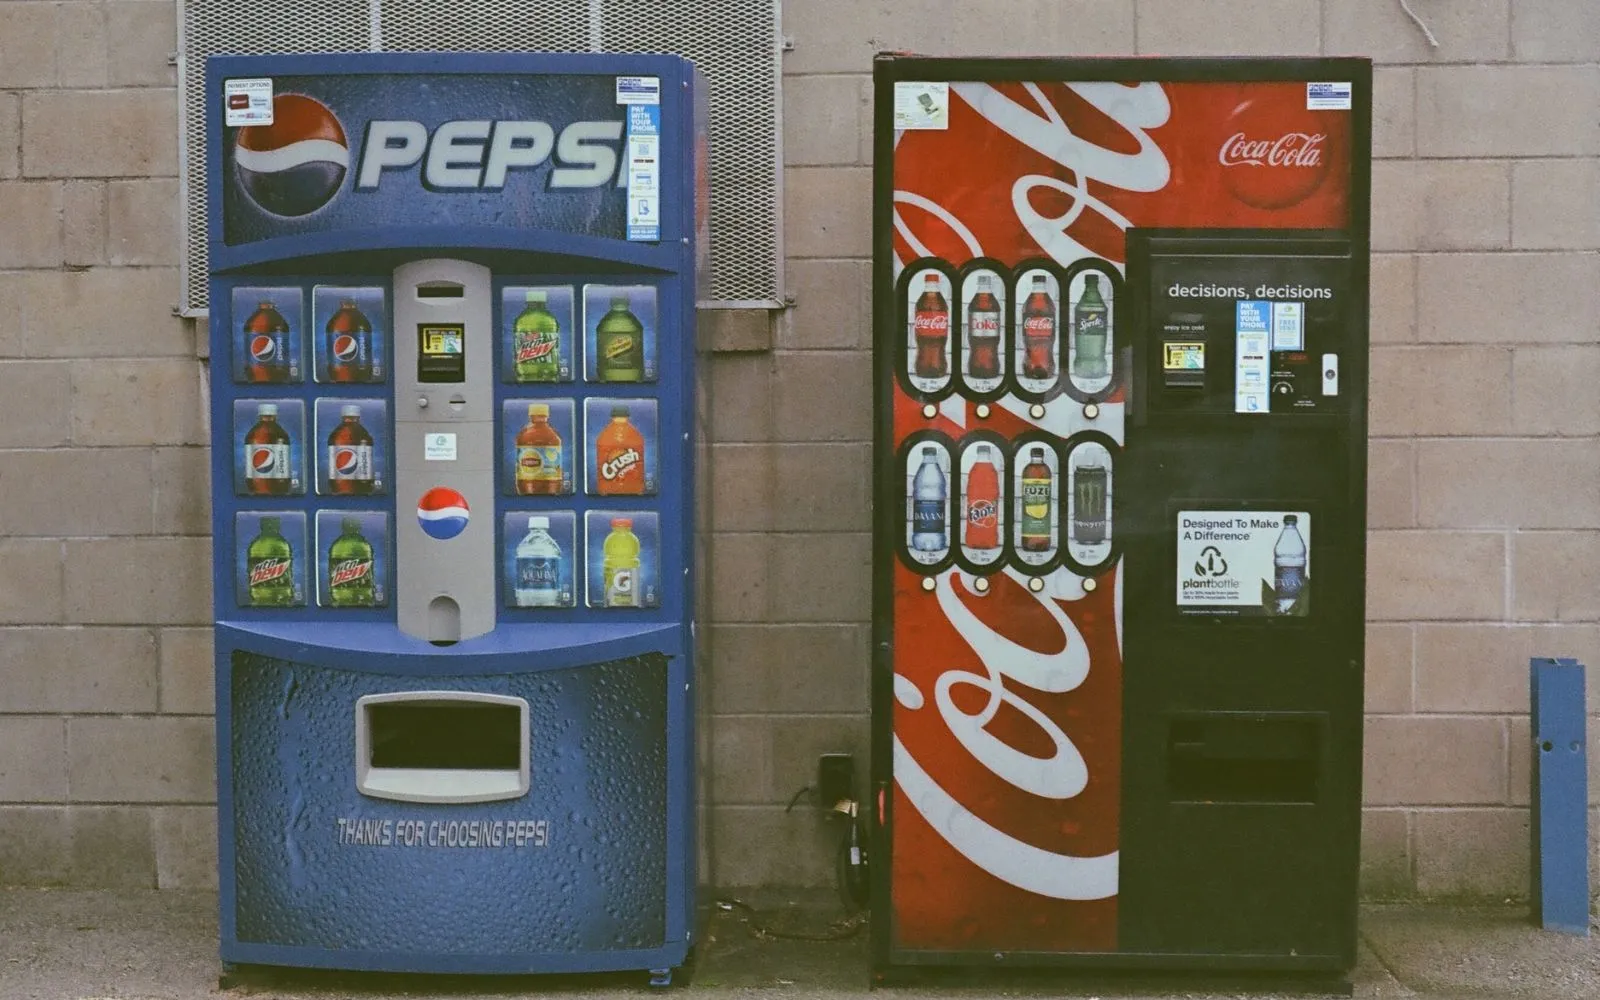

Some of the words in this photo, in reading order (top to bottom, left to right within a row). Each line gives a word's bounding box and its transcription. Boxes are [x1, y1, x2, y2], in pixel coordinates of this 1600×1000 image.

[356, 119, 628, 192] PEPS
[1219, 132, 1327, 166] Coca-Cola
[1169, 284, 1250, 300] decisions,
[1255, 284, 1332, 299] decisions
[915, 315, 948, 329] Coca-Cola
[1080, 318, 1104, 330] Sprite
[602, 448, 640, 480] Crush
[1183, 518, 1233, 530] Designed
[1234, 519, 1248, 528] To
[1250, 519, 1279, 528] Make
[1183, 531, 1192, 540] A
[1194, 531, 1250, 540] Difference
[1183, 578, 1240, 590] plantbottle
[338, 817, 391, 846] THANKS
[394, 819, 426, 846] FOR
[428, 819, 502, 848] CHOOSING
[504, 820, 549, 847] PEPSI
